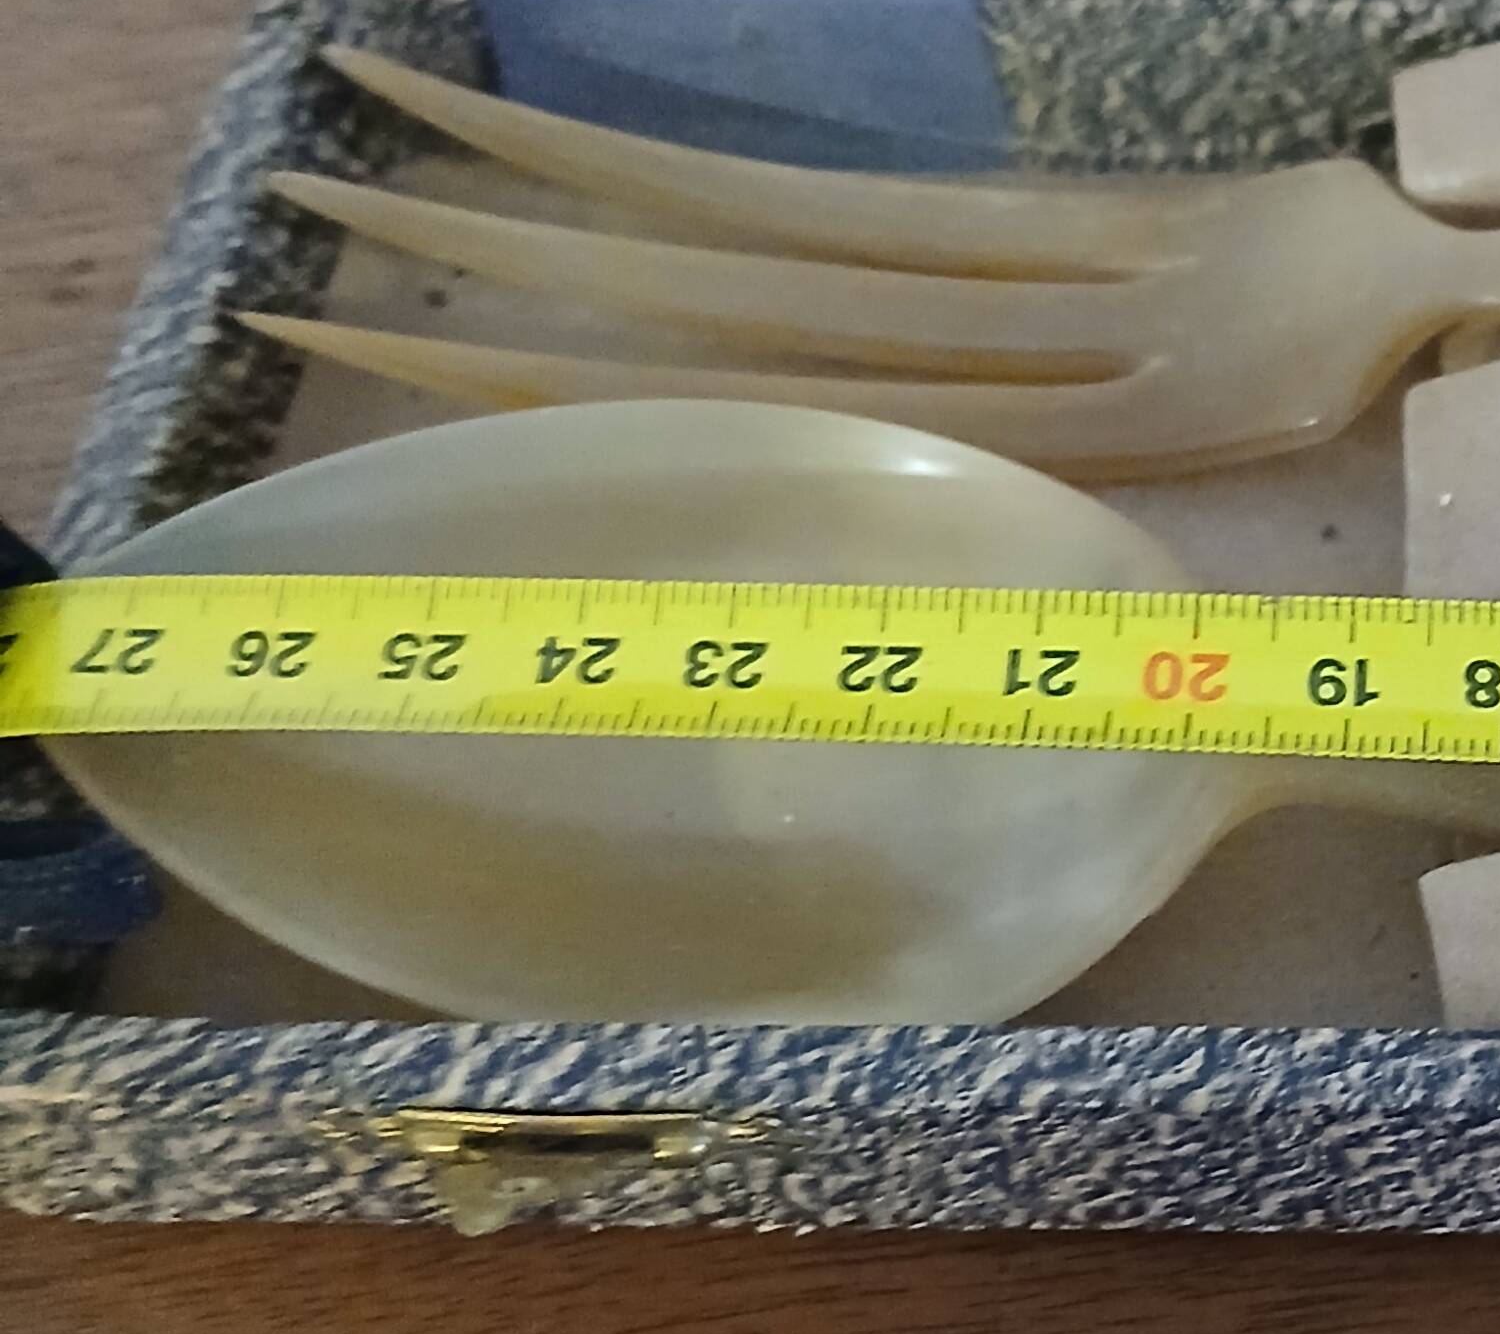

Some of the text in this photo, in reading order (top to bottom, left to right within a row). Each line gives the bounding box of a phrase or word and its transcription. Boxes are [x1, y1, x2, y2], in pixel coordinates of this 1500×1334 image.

[68, 627, 166, 677] 27
[227, 629, 318, 680] 26
[376, 631, 468, 682] 25
[534, 635, 622, 686] 24
[682, 639, 770, 691] 23
[837, 644, 925, 695] 22
[1001, 647, 1082, 698] 21
[1141, 649, 1232, 704] 20
[1307, 657, 1381, 708] 19
